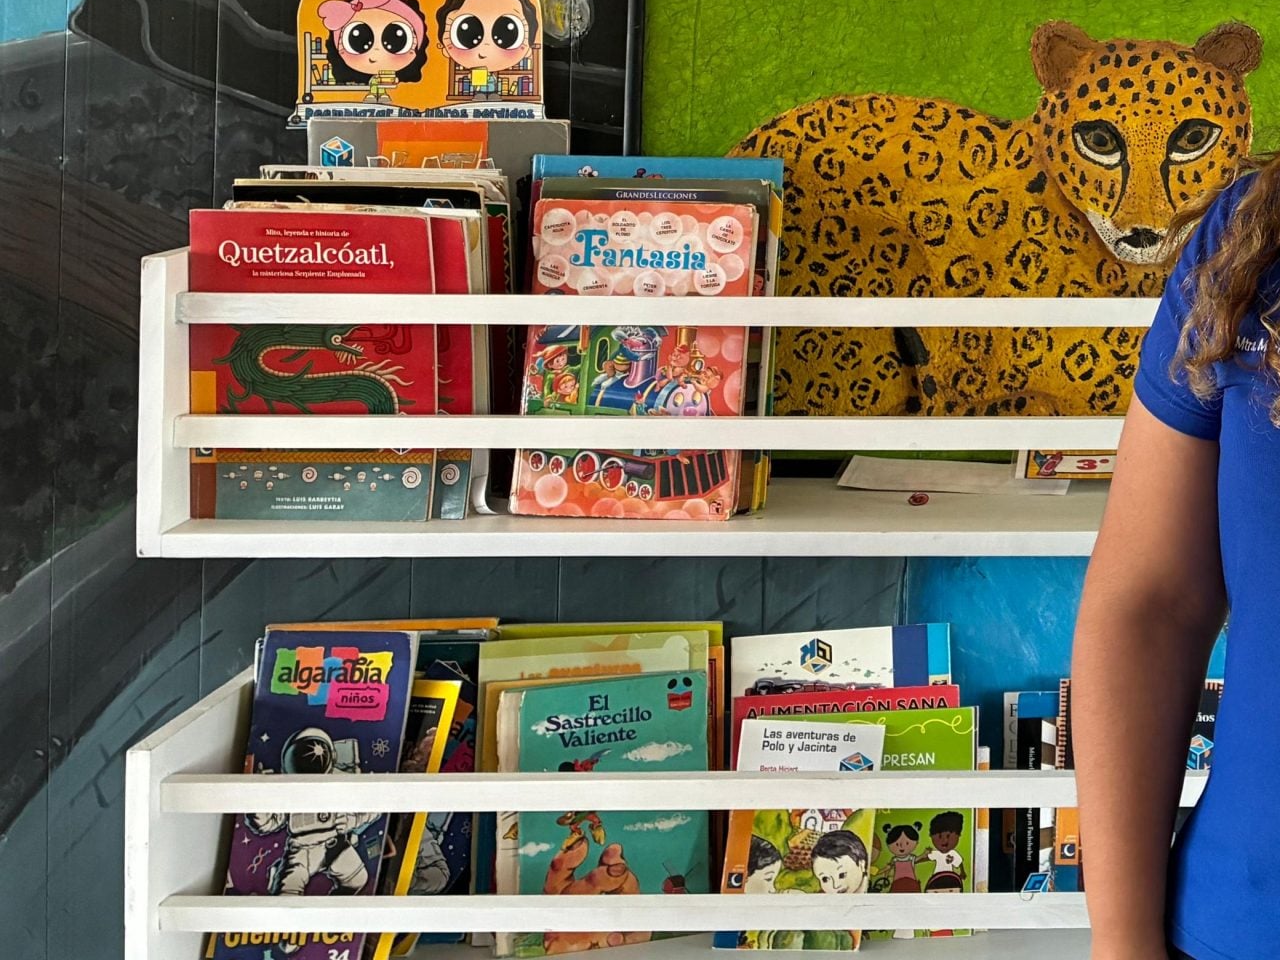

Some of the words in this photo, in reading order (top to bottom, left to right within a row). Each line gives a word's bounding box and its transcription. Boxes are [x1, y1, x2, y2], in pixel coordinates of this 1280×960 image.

[218, 239, 395, 269] Quetzalcóatl,
[570, 229, 707, 271] Fantasia
[277, 656, 383, 690] algarabía
[340, 692, 375, 704] niños
[588, 694, 610, 712] El
[897, 696, 949, 710] SANA
[545, 706, 653, 733] Sastrecillo
[558, 727, 638, 749] Valiente
[763, 728, 782, 739] Las
[786, 730, 842, 742] aventuras
[843, 731, 856, 743] de
[762, 740, 785, 752] Polo
[788, 743, 795, 754] y
[798, 742, 838, 753] Jacinta
[883, 752, 936, 767] PRESAN
